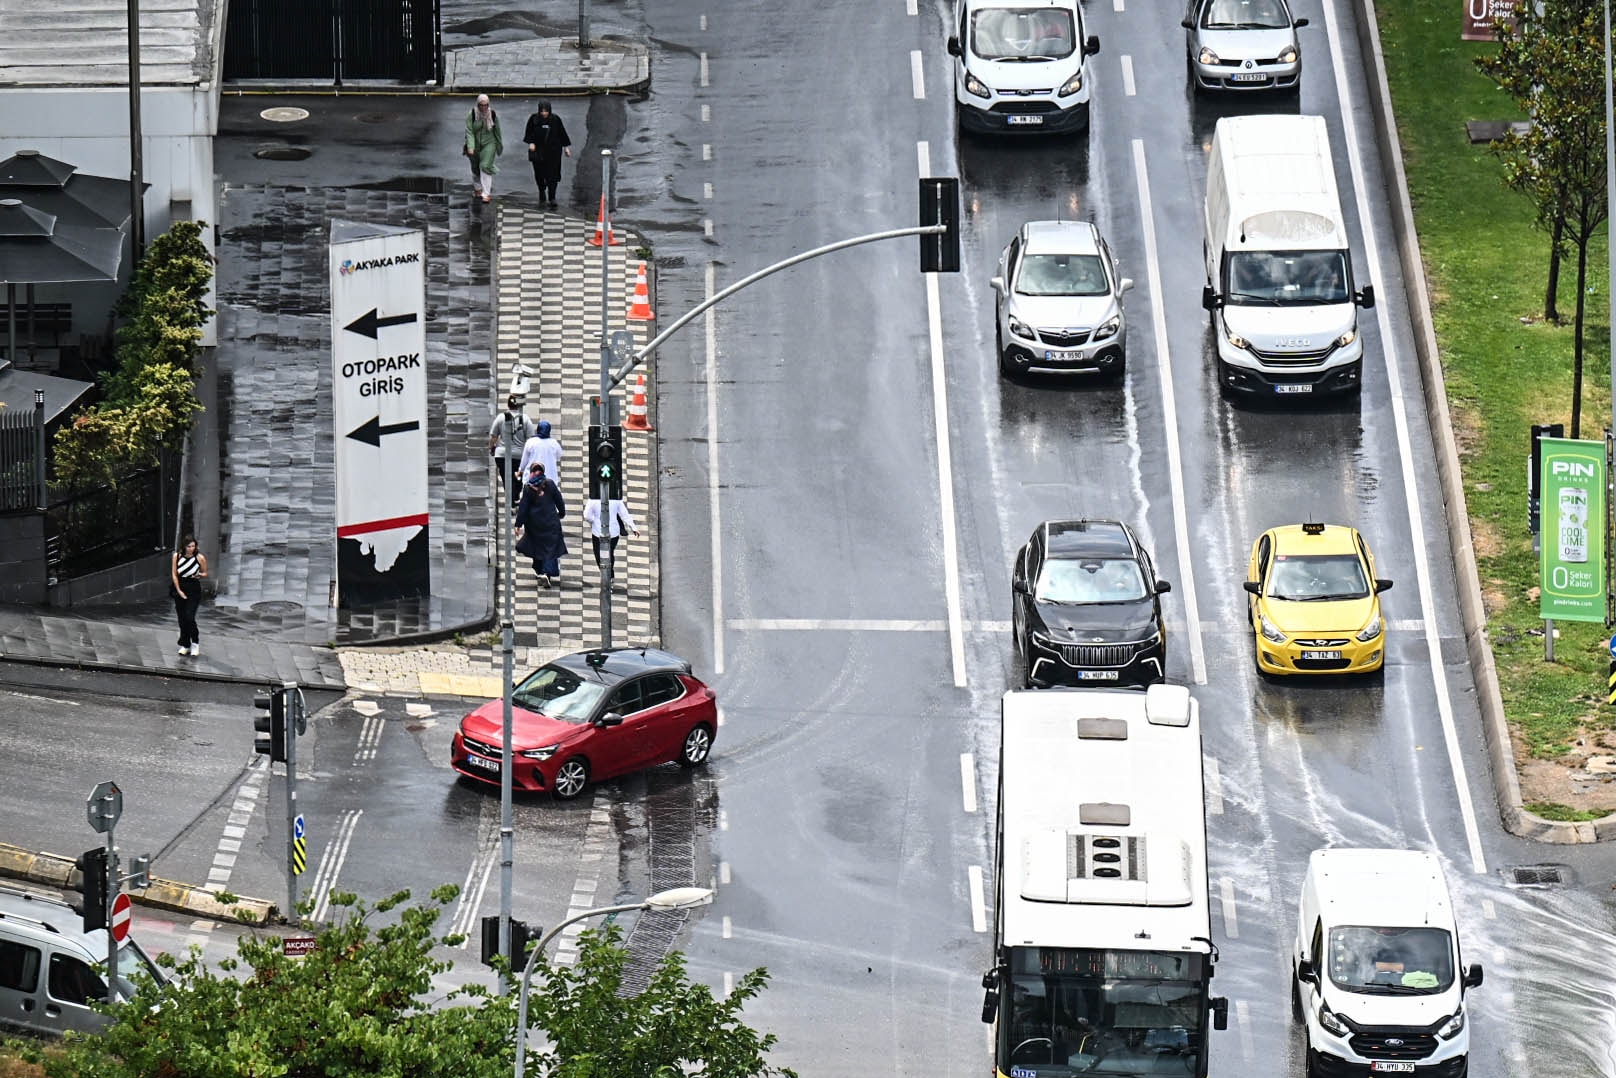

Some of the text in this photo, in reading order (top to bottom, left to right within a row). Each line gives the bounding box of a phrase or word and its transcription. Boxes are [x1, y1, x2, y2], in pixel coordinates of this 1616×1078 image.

[355, 253, 420, 271] AKYAKA PARK
[342, 353, 421, 378] OTOPARK
[360, 375, 404, 397] GİRİŞ
[1552, 461, 1594, 477] PIN
[1560, 495, 1586, 506] PIN
[1552, 566, 1568, 589] 0
[1570, 571, 1592, 580] Şeker
[1570, 579, 1593, 589] Kalori
[286, 942, 315, 950] AKÇAKO
